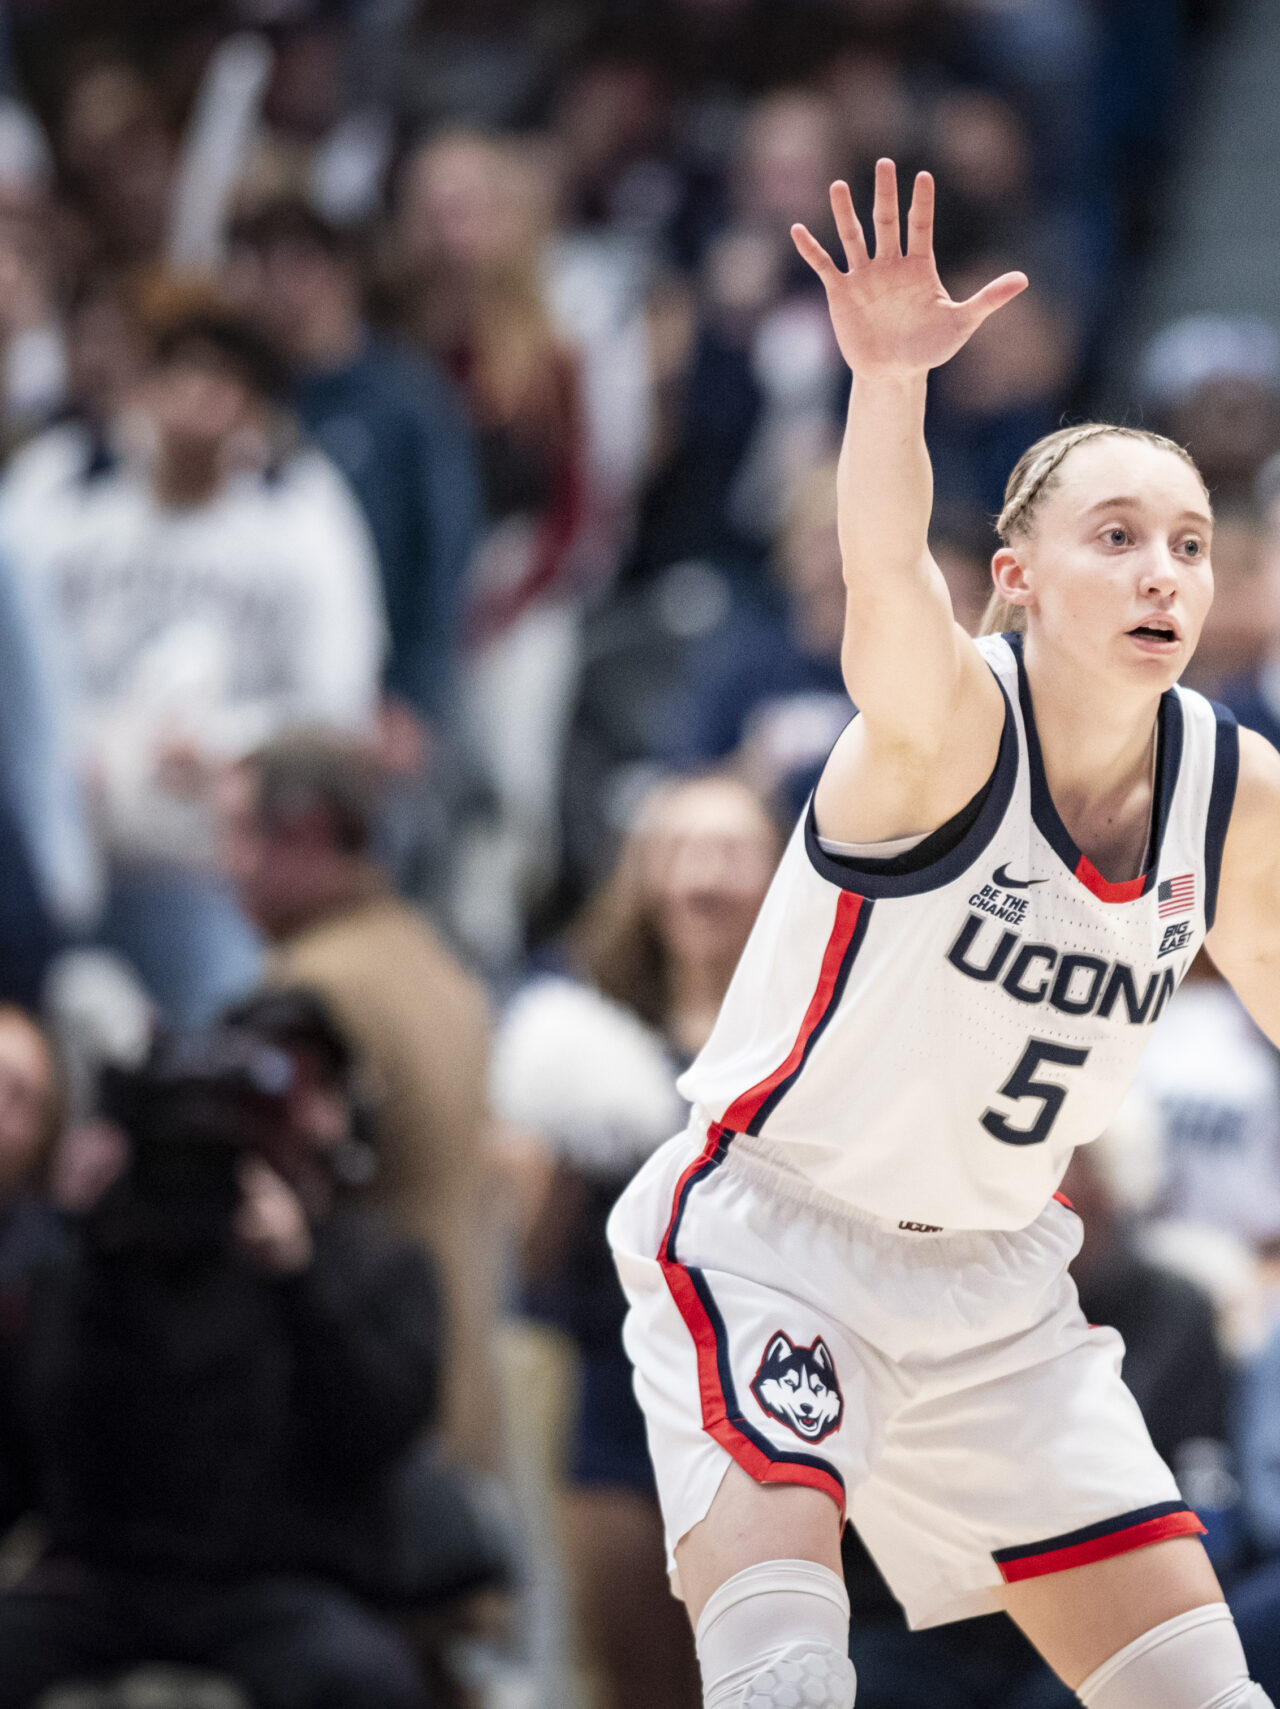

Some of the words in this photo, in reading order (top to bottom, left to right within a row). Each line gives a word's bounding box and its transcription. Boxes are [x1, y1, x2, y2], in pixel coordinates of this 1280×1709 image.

[968, 894, 1026, 925] CHANGE
[980, 884, 1002, 902] BE
[1002, 893, 1029, 913] THE
[1158, 931, 1194, 953] EAST
[1163, 920, 1190, 939] BIG
[978, 1034, 1093, 1147] 5
